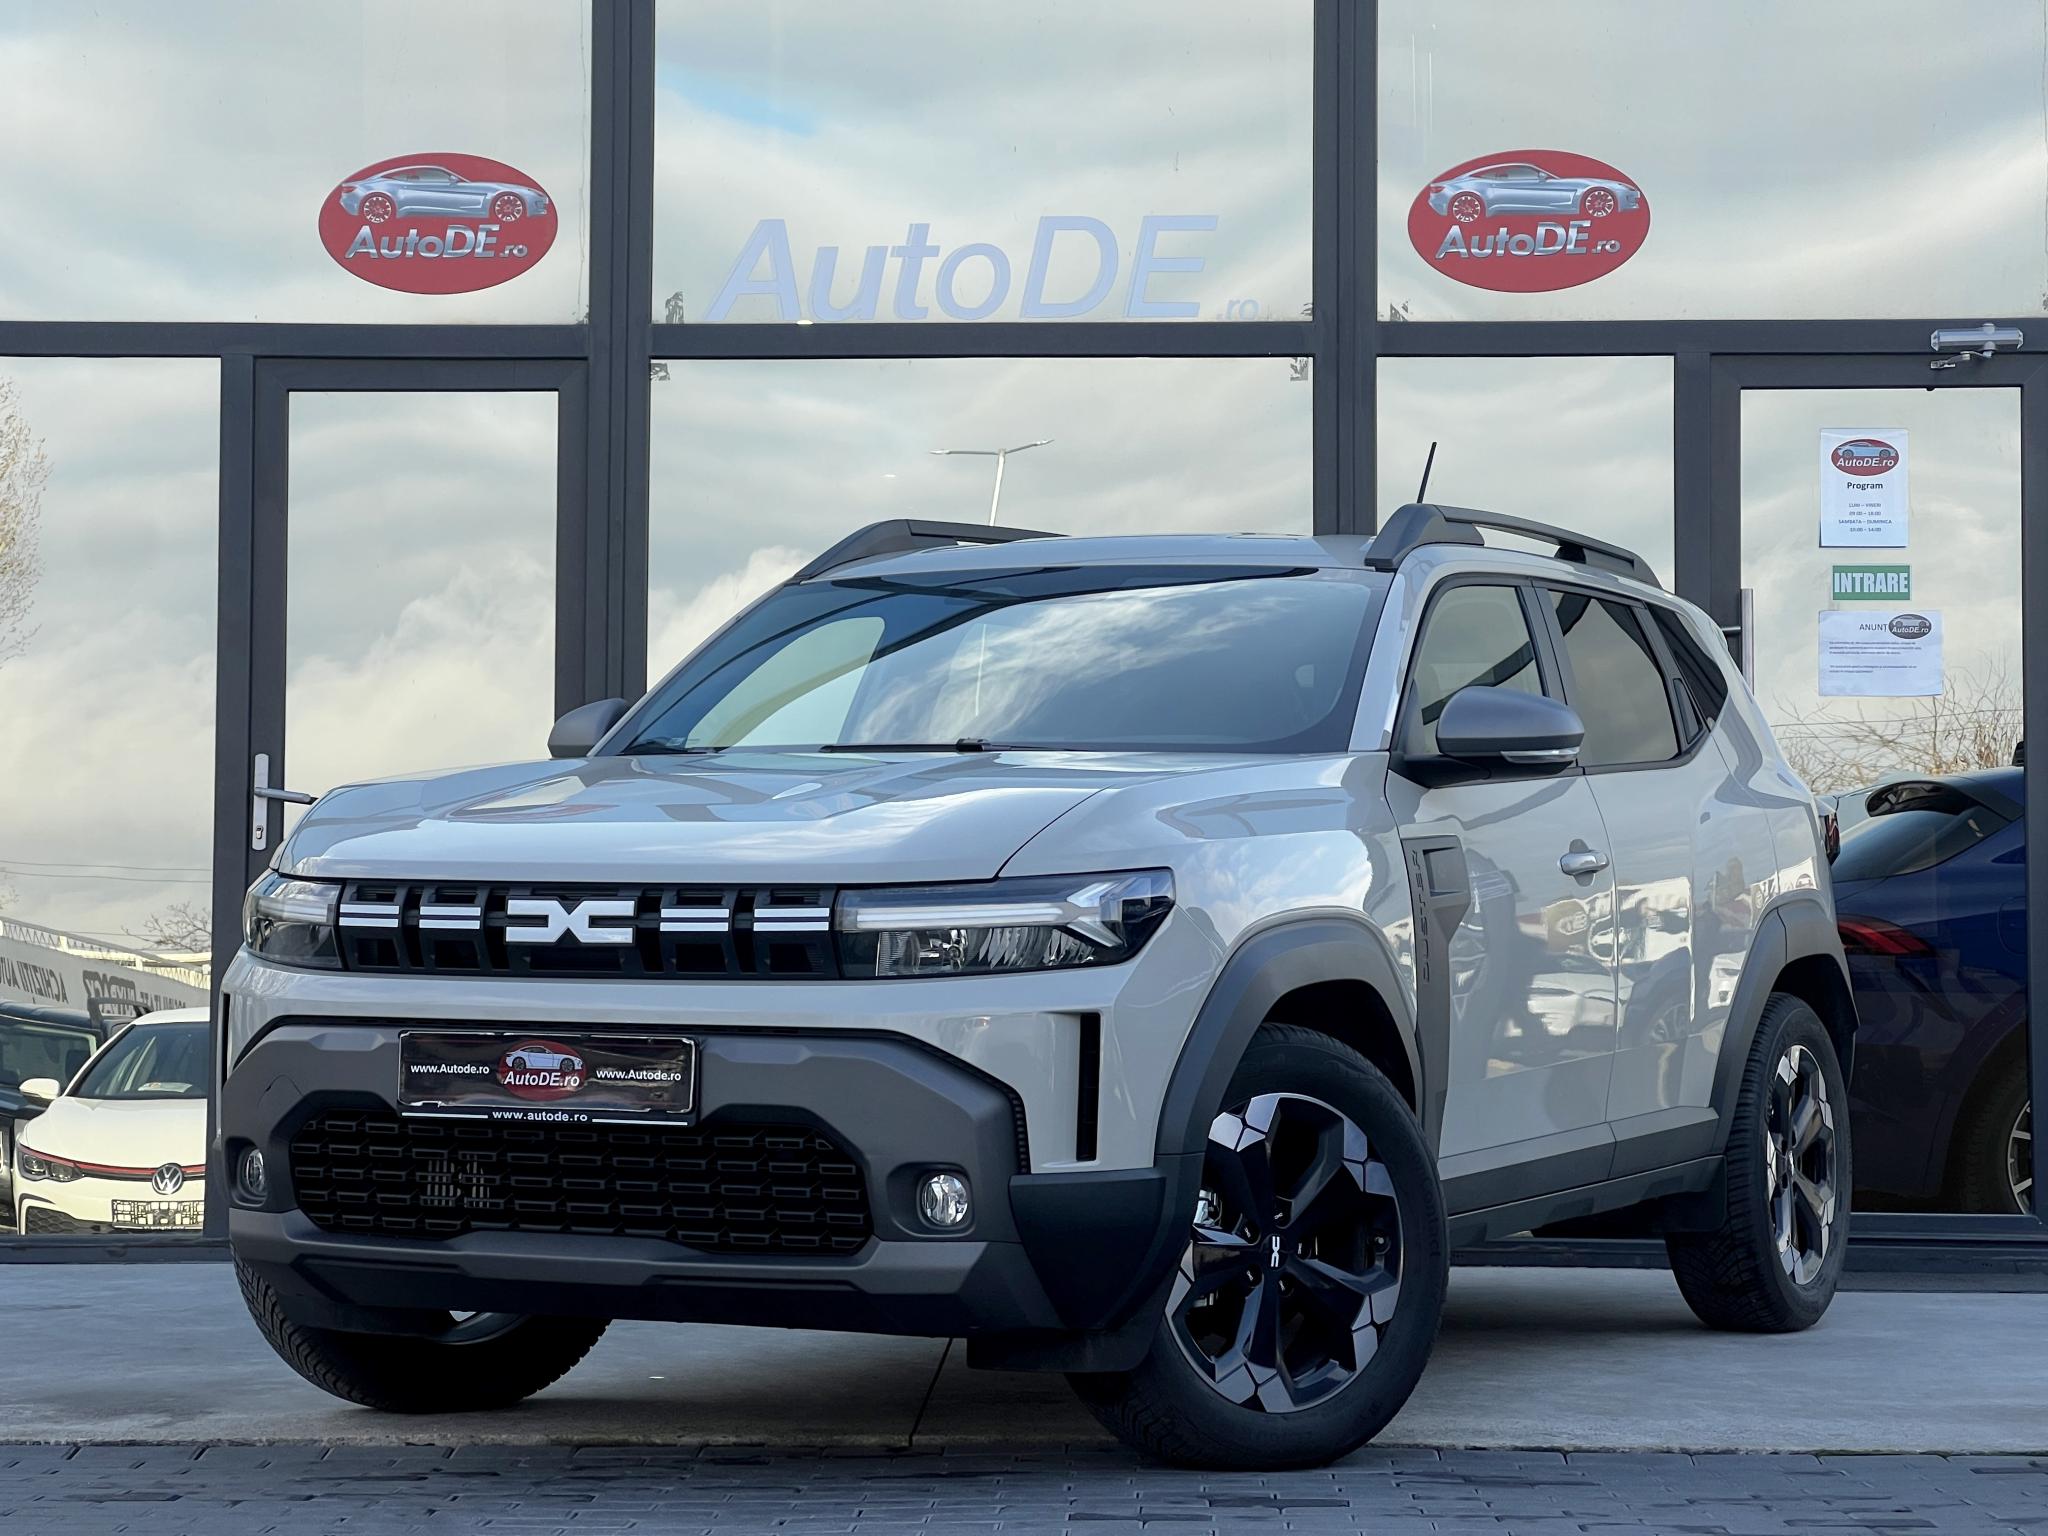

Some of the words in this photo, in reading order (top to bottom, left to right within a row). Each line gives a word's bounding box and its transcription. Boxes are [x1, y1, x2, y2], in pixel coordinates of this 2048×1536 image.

[1836, 457, 1895, 467] AutoDE.ro
[1847, 481, 1883, 490] Program
[1834, 572, 1909, 593] INTRARE
[410, 1063, 490, 1075] www.Autode.ro
[596, 1068, 682, 1082] www.Autode.ro
[503, 1070, 580, 1087] AutoDE.ro
[492, 1110, 588, 1122] www.autode.ro
